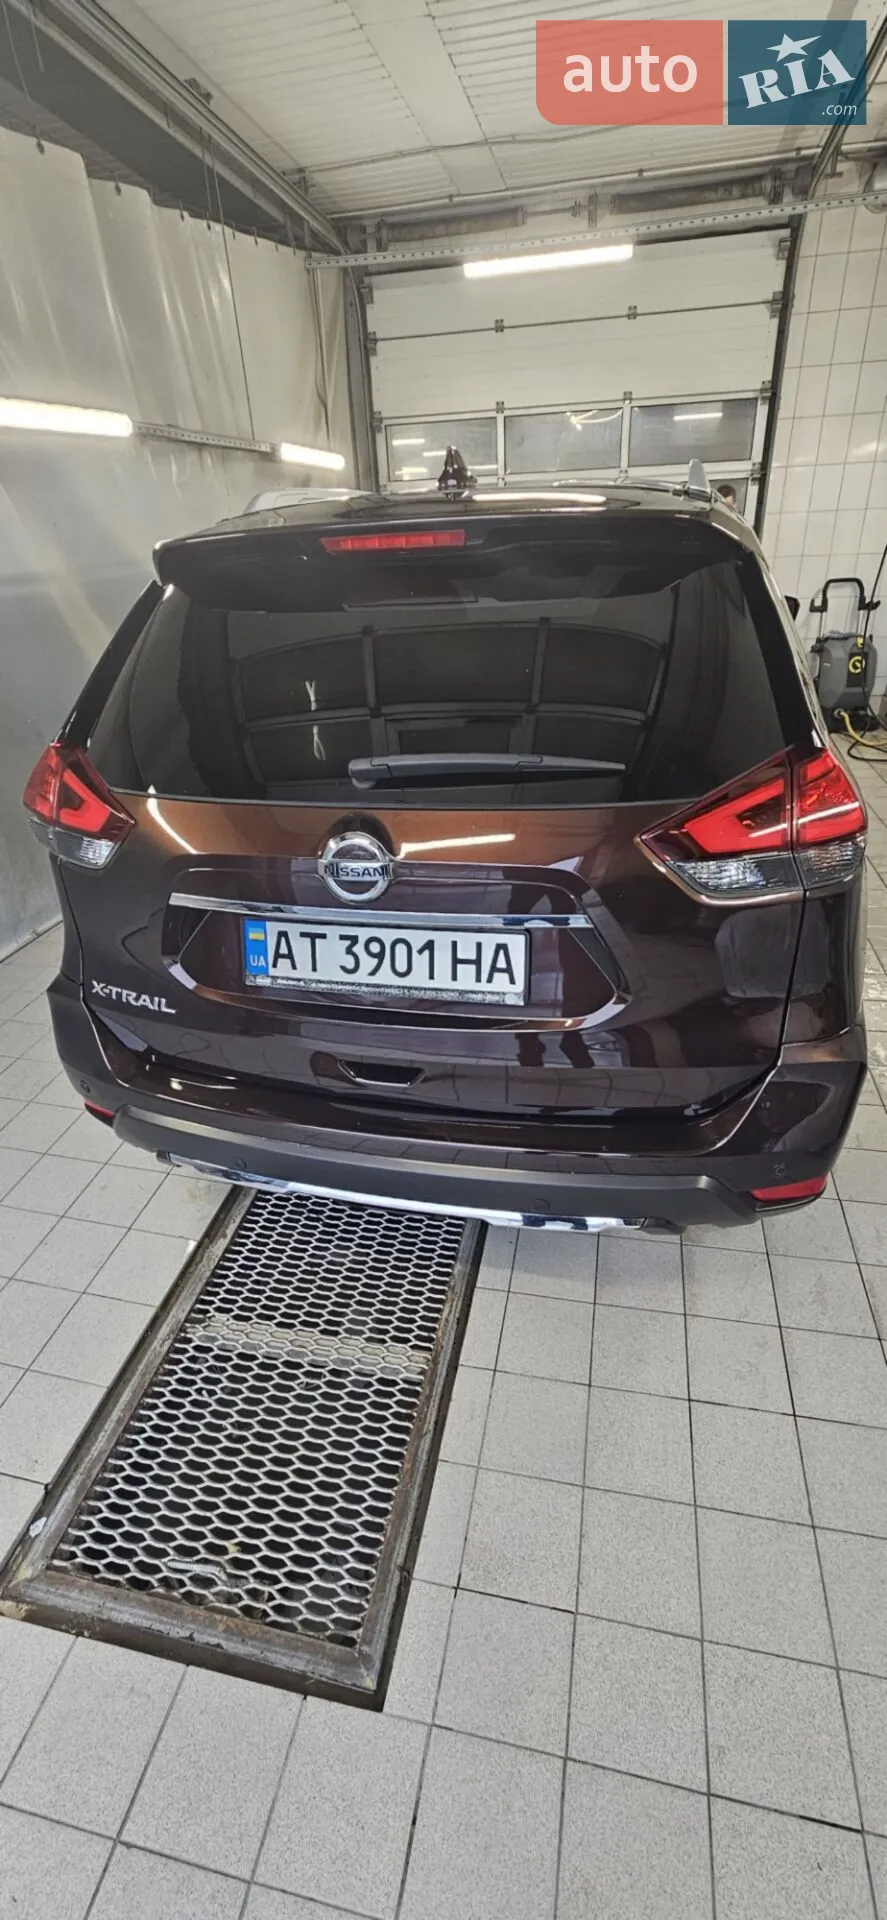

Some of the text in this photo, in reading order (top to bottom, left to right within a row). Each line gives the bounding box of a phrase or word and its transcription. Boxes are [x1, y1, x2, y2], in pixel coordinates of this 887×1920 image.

[324, 862, 389, 878] NISSAN
[250, 955, 266, 968] UA
[271, 930, 517, 985] AT 3901 HA
[92, 979, 176, 1014] X-TRAIL
